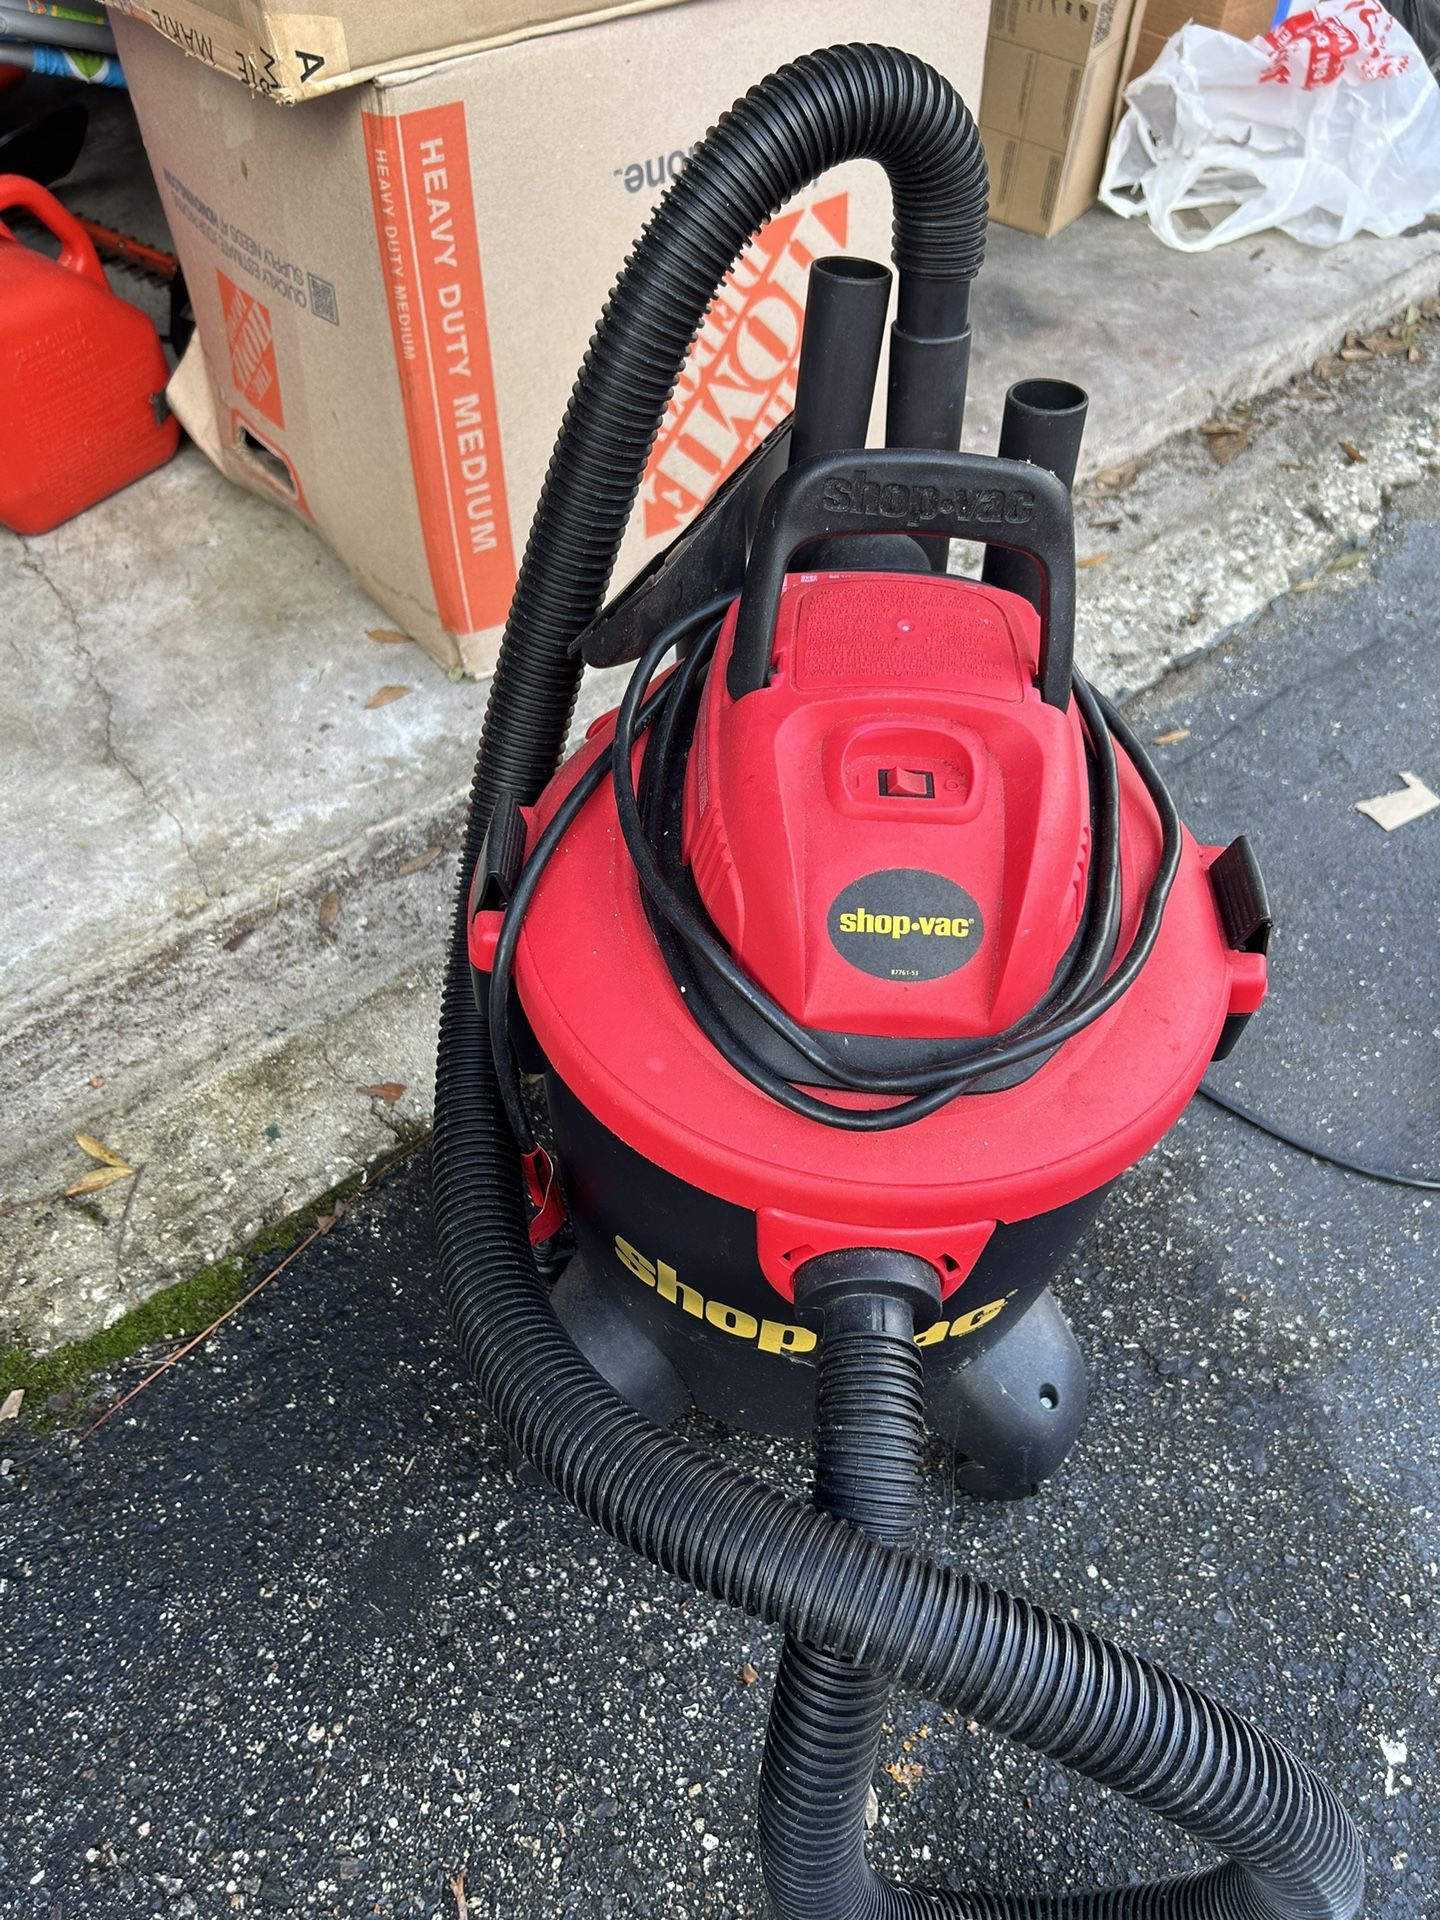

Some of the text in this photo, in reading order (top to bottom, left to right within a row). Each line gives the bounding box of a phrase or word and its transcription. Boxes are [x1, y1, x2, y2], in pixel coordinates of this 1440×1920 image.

[374, 148, 416, 360] HEAVY DUTY MEDIUM
[619, 146, 697, 194] one.
[419, 137, 499, 556] HEAVY DUTY MEDIUM
